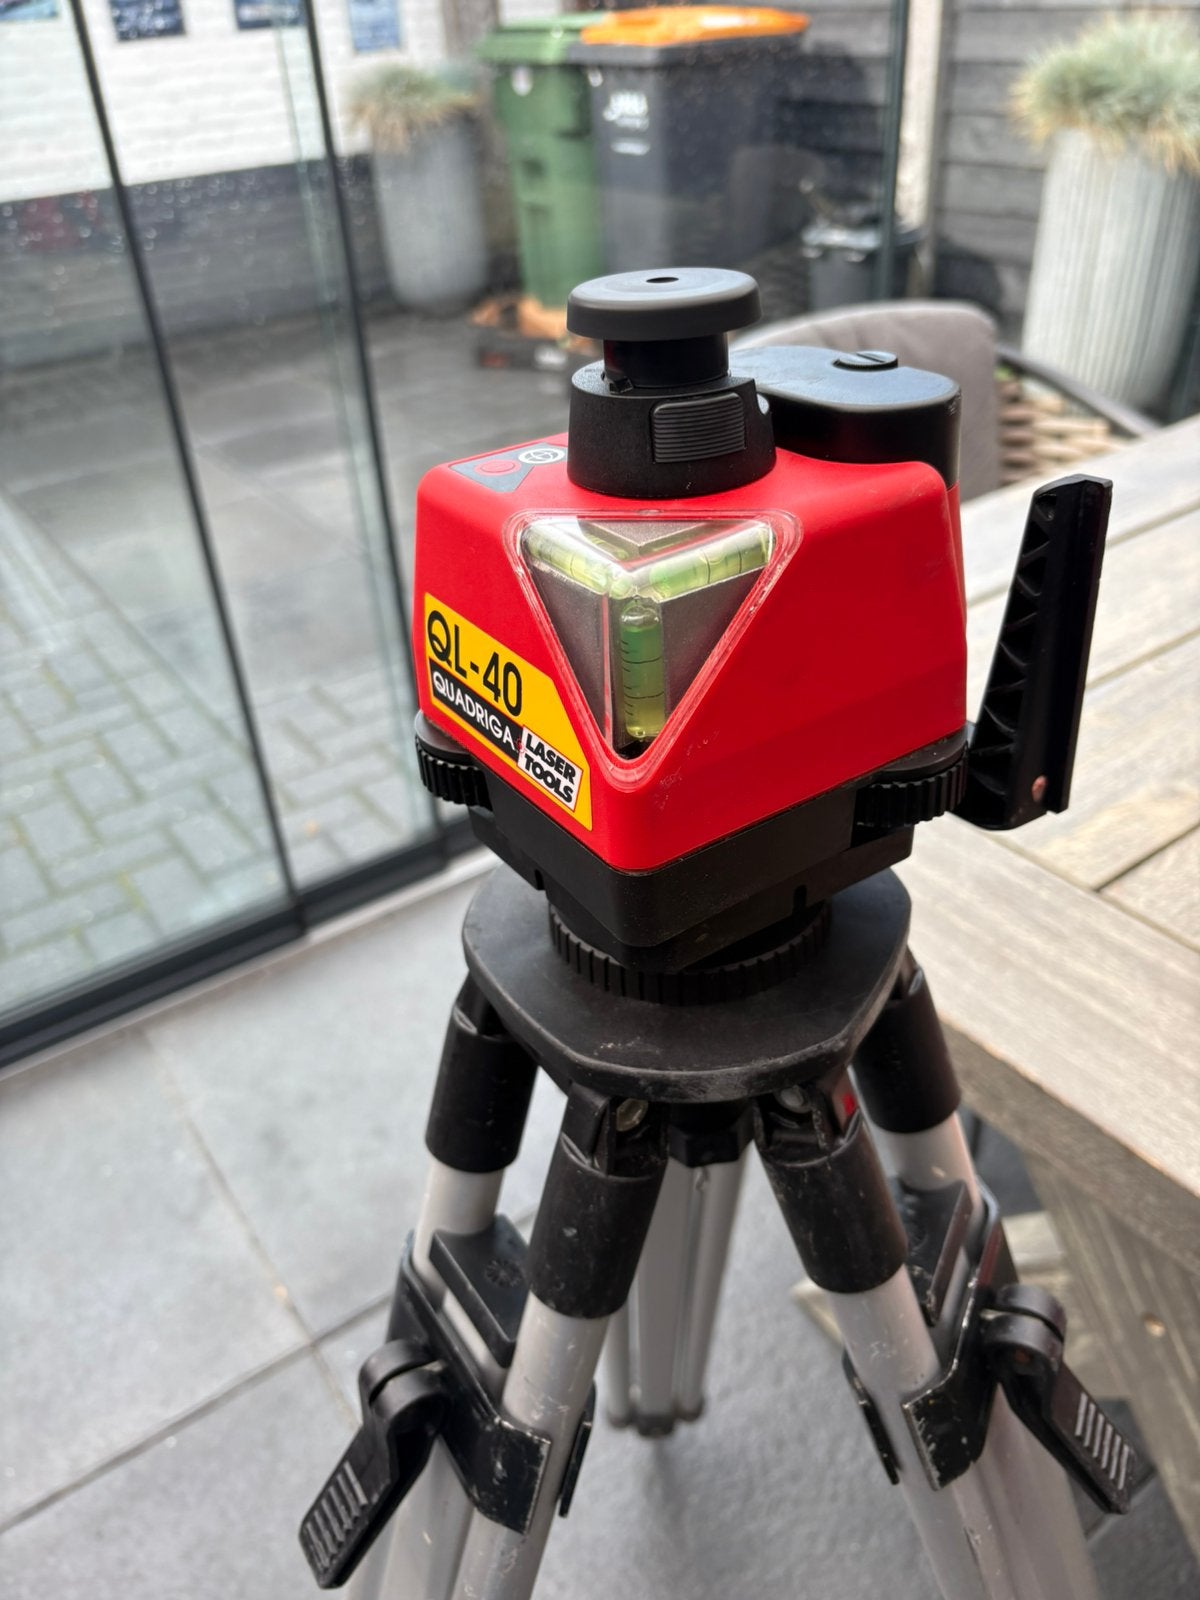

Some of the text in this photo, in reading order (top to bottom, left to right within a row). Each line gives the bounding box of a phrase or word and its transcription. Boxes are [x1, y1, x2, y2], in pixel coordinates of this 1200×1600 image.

[427, 610, 522, 717] QL-40
[433, 671, 515, 750] QUADRIGA
[524, 753, 573, 804] TOOLS
[526, 734, 576, 785] LASER
